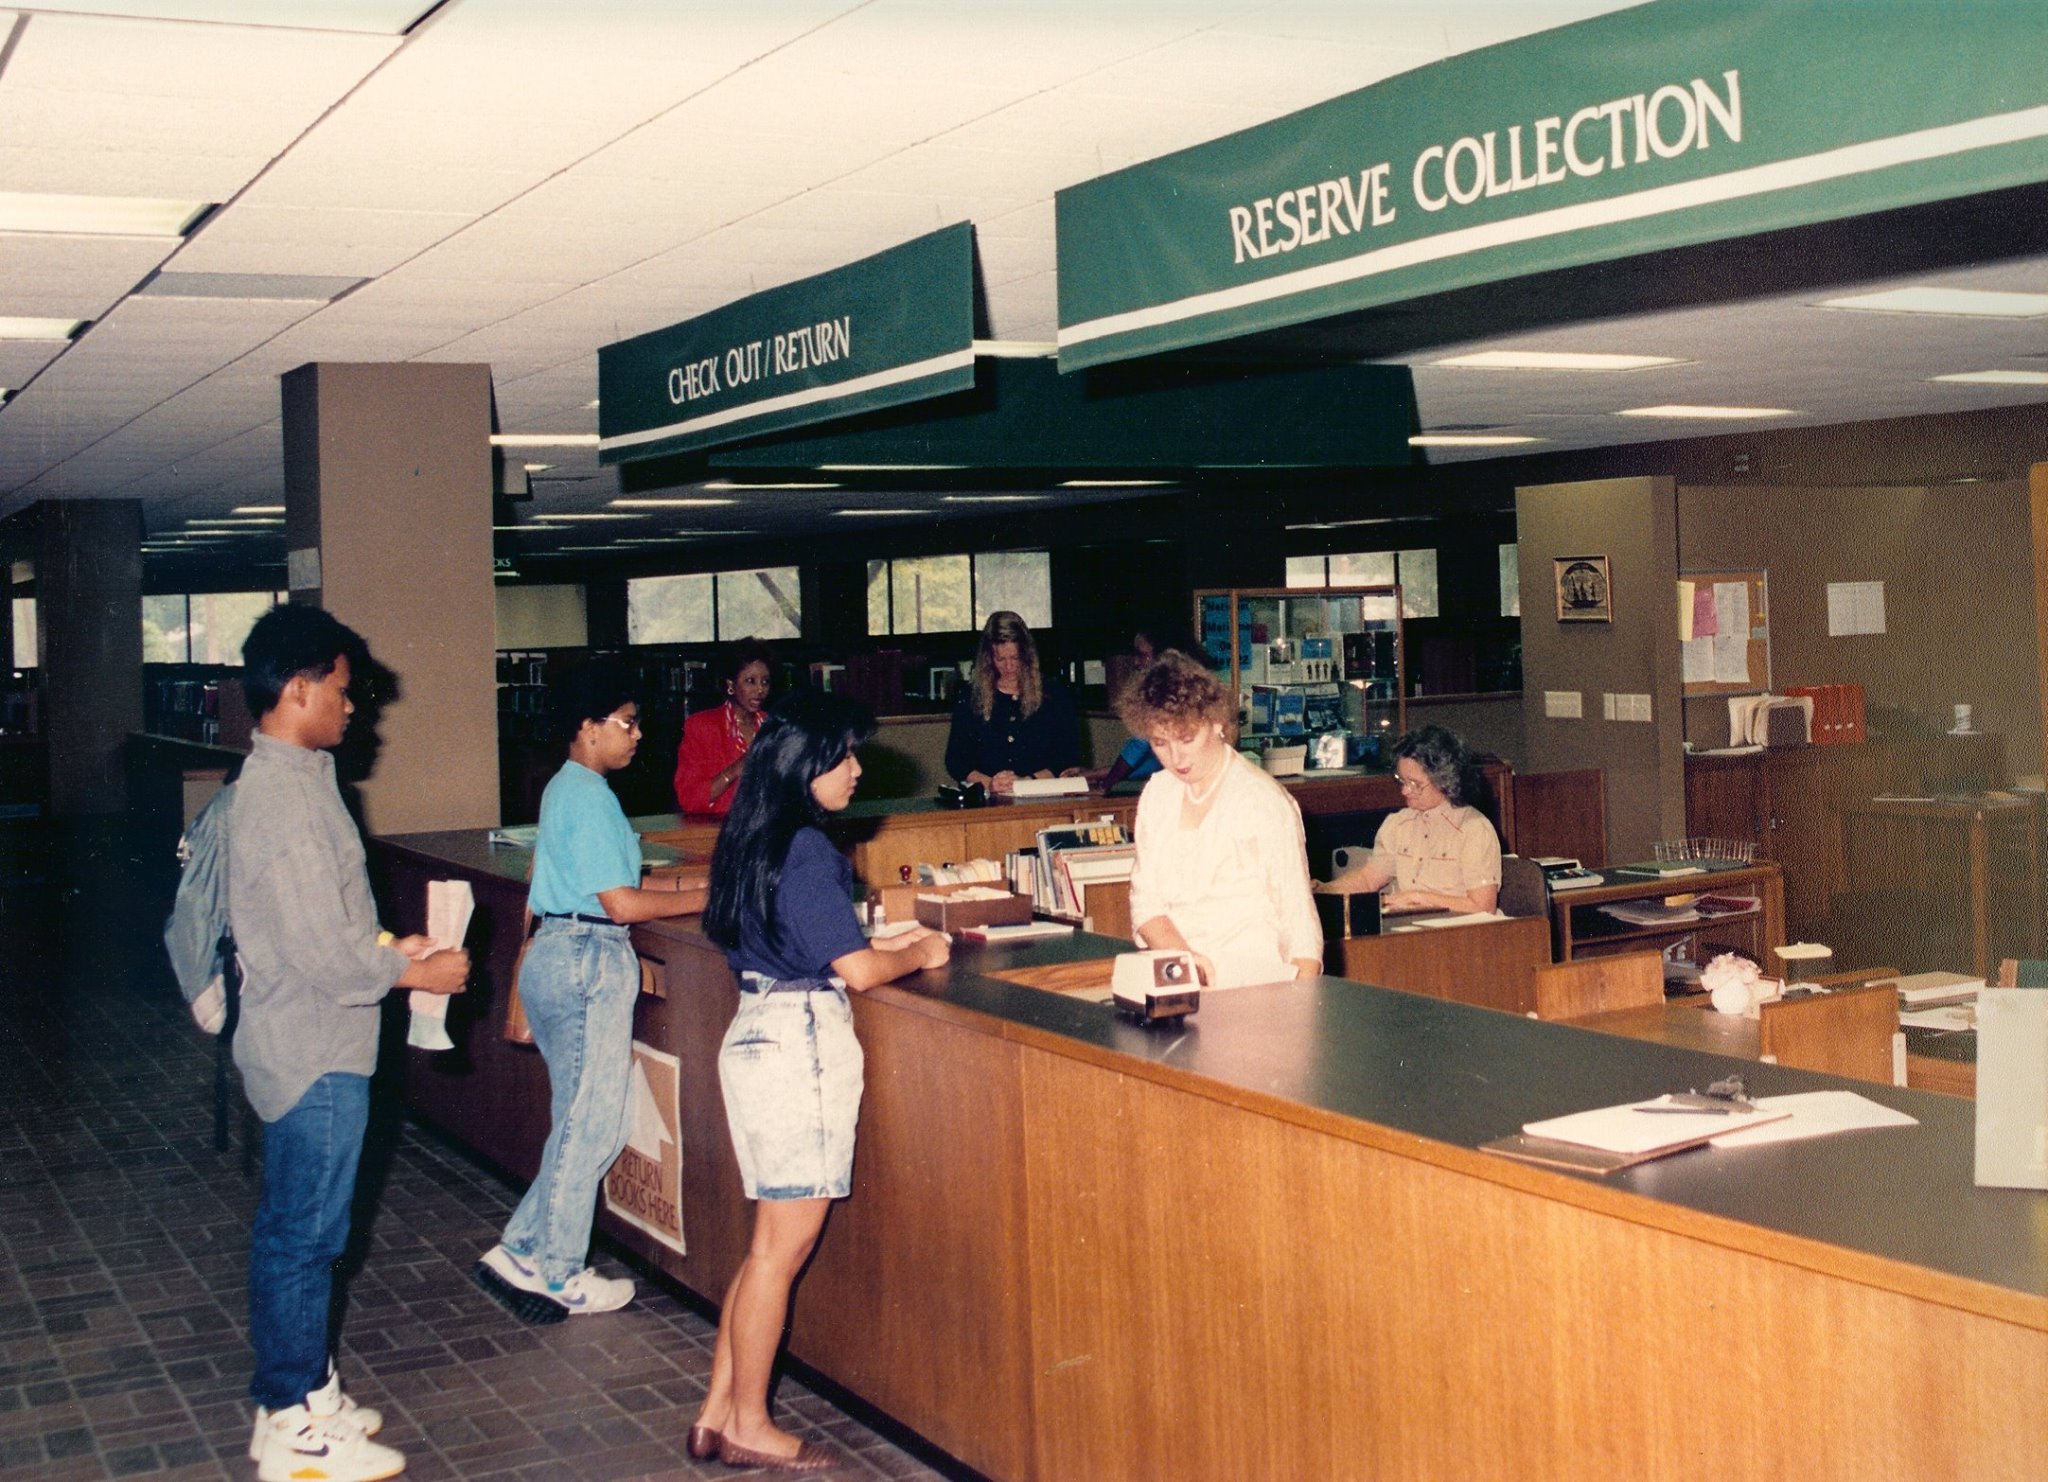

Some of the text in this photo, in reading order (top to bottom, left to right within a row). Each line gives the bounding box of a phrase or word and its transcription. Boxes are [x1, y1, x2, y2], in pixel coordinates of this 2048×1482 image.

[1229, 69, 1743, 264] RESERVE COLLECTION
[669, 356, 720, 405] CHECK
[610, 1169, 679, 1232] BOOKS HERE
[621, 1151, 664, 1194] RETURN
